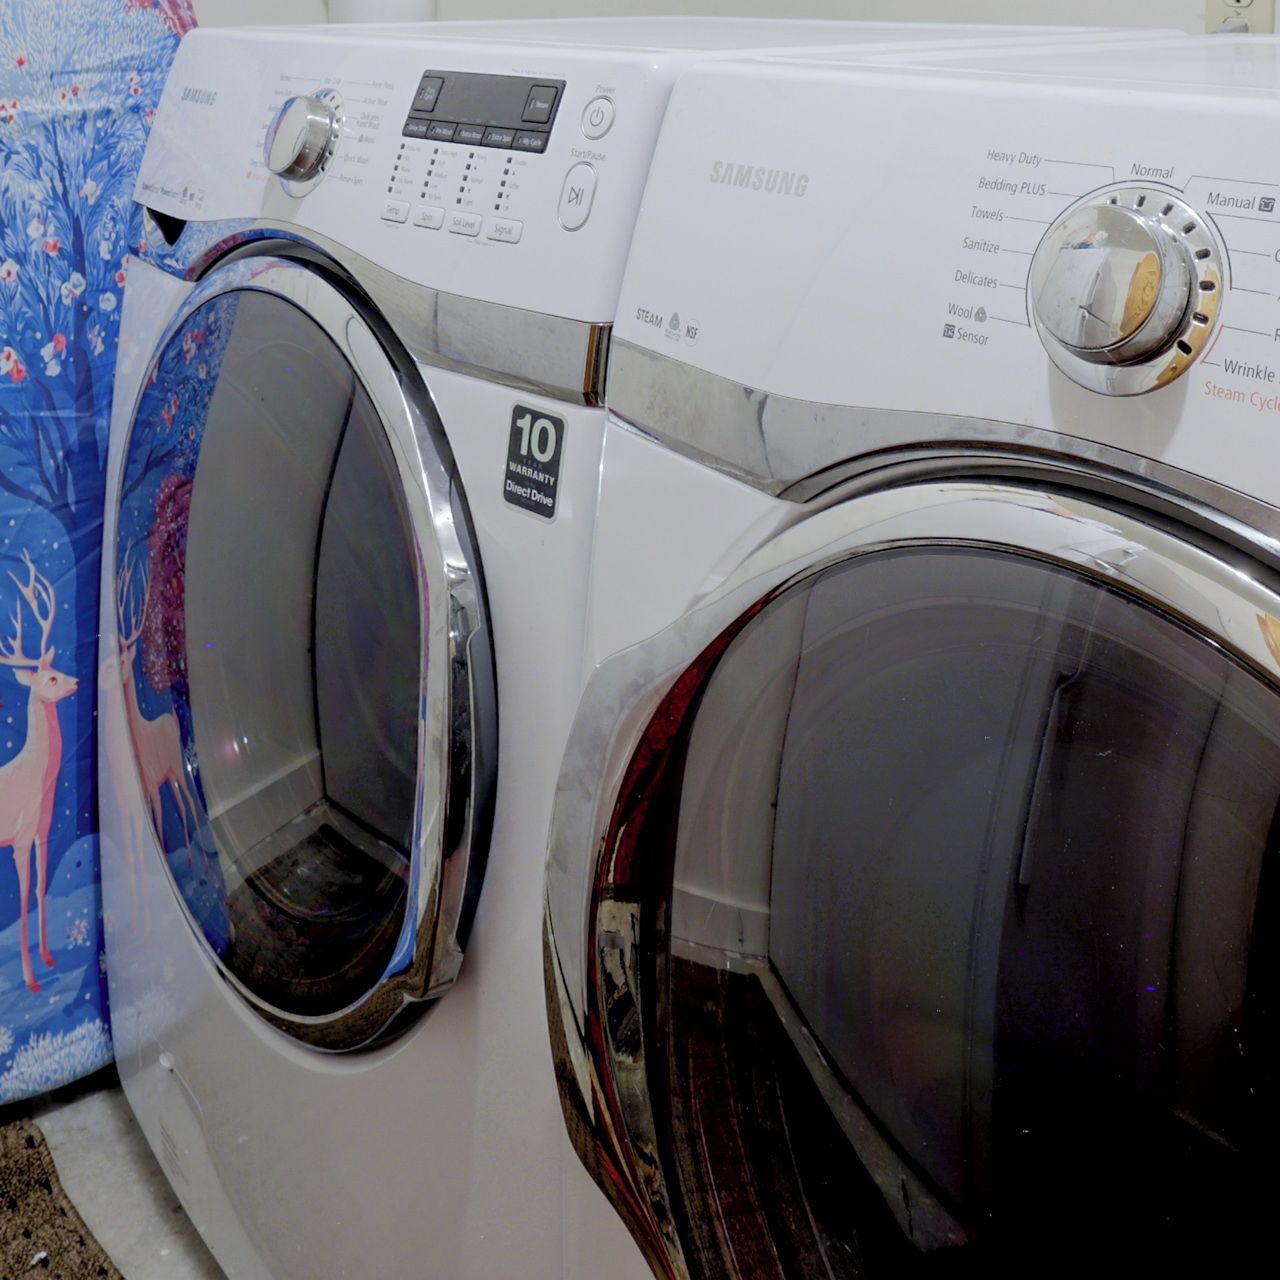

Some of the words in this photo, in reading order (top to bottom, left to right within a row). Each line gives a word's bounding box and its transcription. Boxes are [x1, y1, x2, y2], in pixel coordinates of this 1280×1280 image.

[181, 87, 217, 106] SAMSUNG
[986, 149, 1016, 165] Heavy
[1018, 152, 1043, 167] Duty
[709, 160, 810, 198] SAMSUNG
[1130, 163, 1175, 179] Normal
[978, 176, 1018, 196] Bedding
[1019, 182, 1047, 197] PLUS
[1206, 191, 1255, 210] Manual
[971, 205, 1005, 222] Towels
[494, 223, 514, 236] Signal
[962, 236, 1001, 255] Sanitize
[954, 269, 999, 289] Delicates
[636, 307, 663, 329] STEAM
[948, 302, 974, 319] Wool
[686, 325, 699, 340] NSF
[956, 327, 990, 346] Sensor
[1223, 358, 1277, 383] Wrinkle
[1204, 380, 1246, 403] Steam
[516, 413, 557, 463] 10
[509, 461, 555, 486] WARRANTY
[505, 479, 531, 499] Direct
[531, 486, 554, 507] Drive
